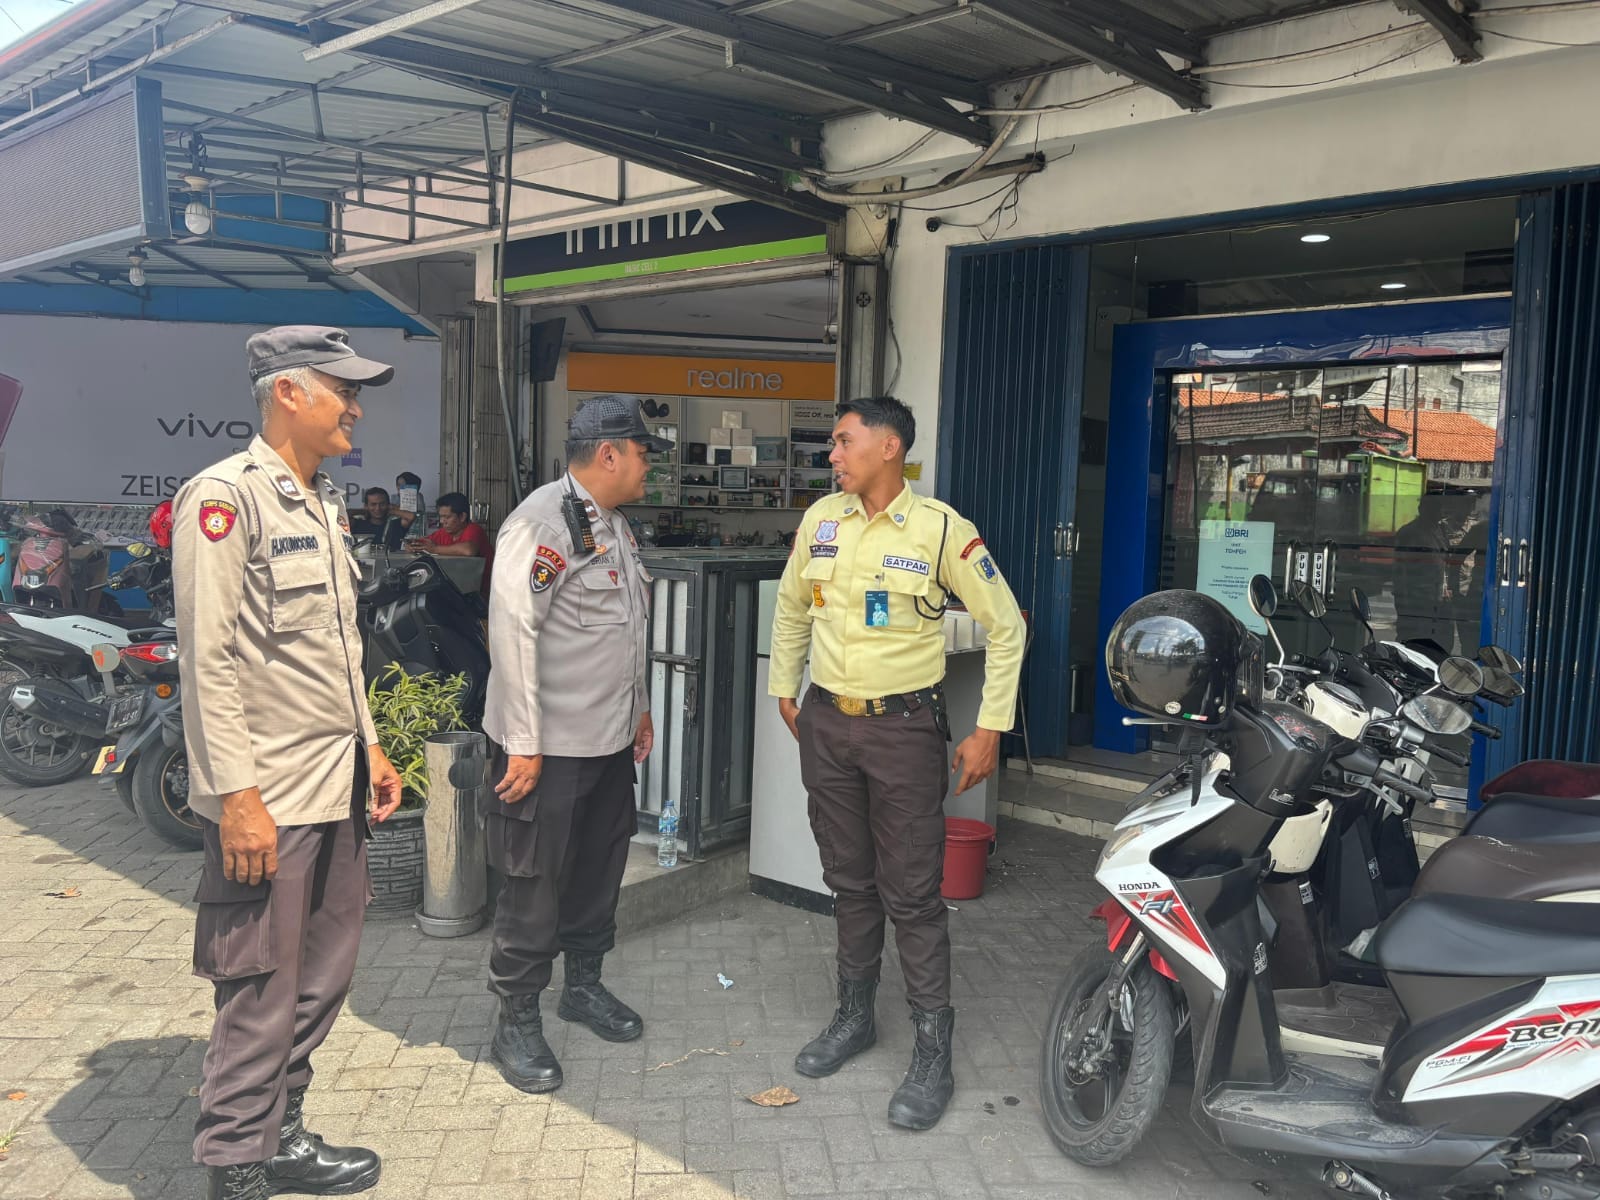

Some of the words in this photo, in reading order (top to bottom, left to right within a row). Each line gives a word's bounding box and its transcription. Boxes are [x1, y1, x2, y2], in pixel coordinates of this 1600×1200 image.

[687, 367, 783, 391] realme
[157, 412, 253, 439] vivo
[1234, 529, 1248, 537] BRI
[885, 557, 928, 574] SATPAM
[1119, 882, 1160, 891] HONDA
